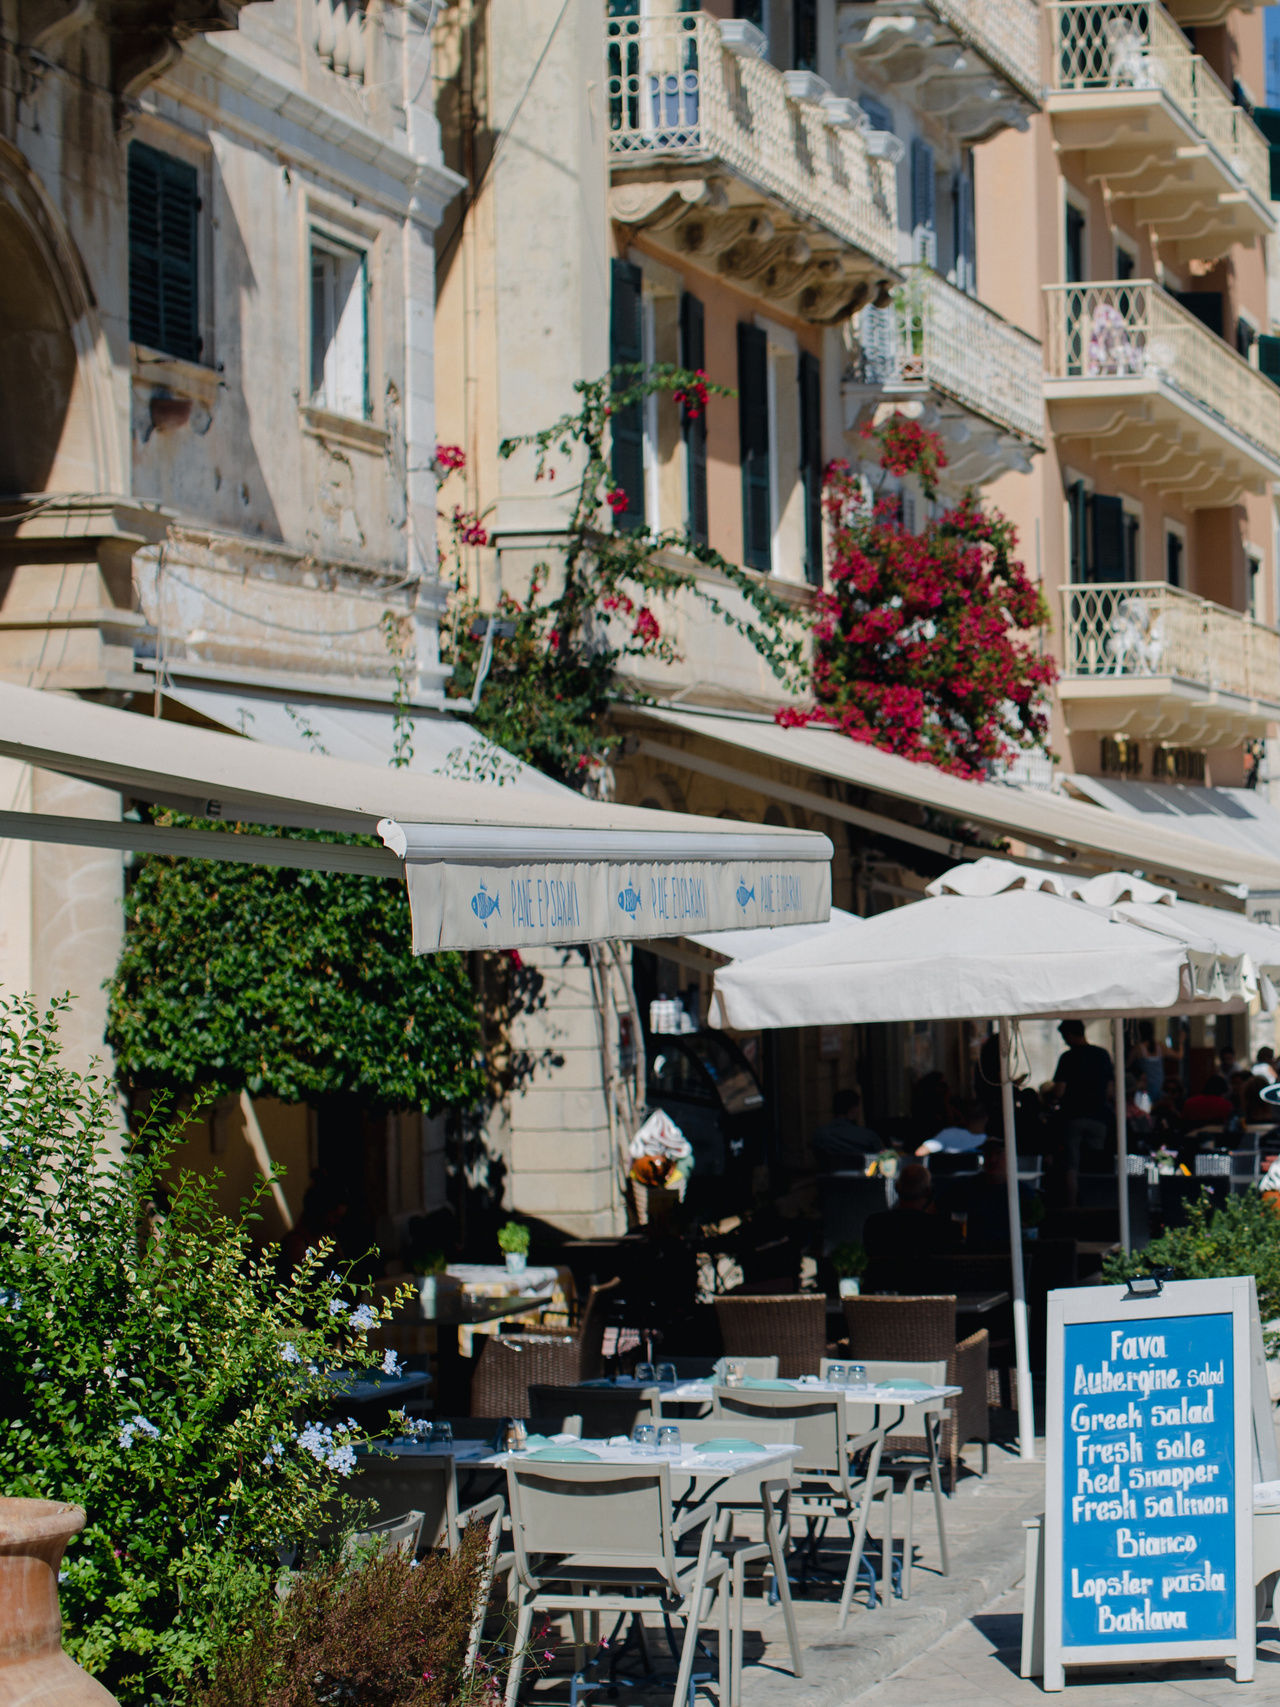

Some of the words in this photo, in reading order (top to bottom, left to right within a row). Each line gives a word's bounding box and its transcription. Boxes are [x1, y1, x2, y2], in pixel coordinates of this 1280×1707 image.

[1111, 1330, 1168, 1361] Fava
[1074, 1360, 1181, 1401] Aubergine
[1071, 1402, 1142, 1432] Greek
[1077, 1432, 1143, 1466] Fresh
[1077, 1464, 1120, 1494] Red
[1072, 1489, 1137, 1523] Fresh
[1072, 1568, 1153, 1604] Lopster
[1162, 1560, 1226, 1599] pasta
[1099, 1598, 1188, 1633] Baklava
